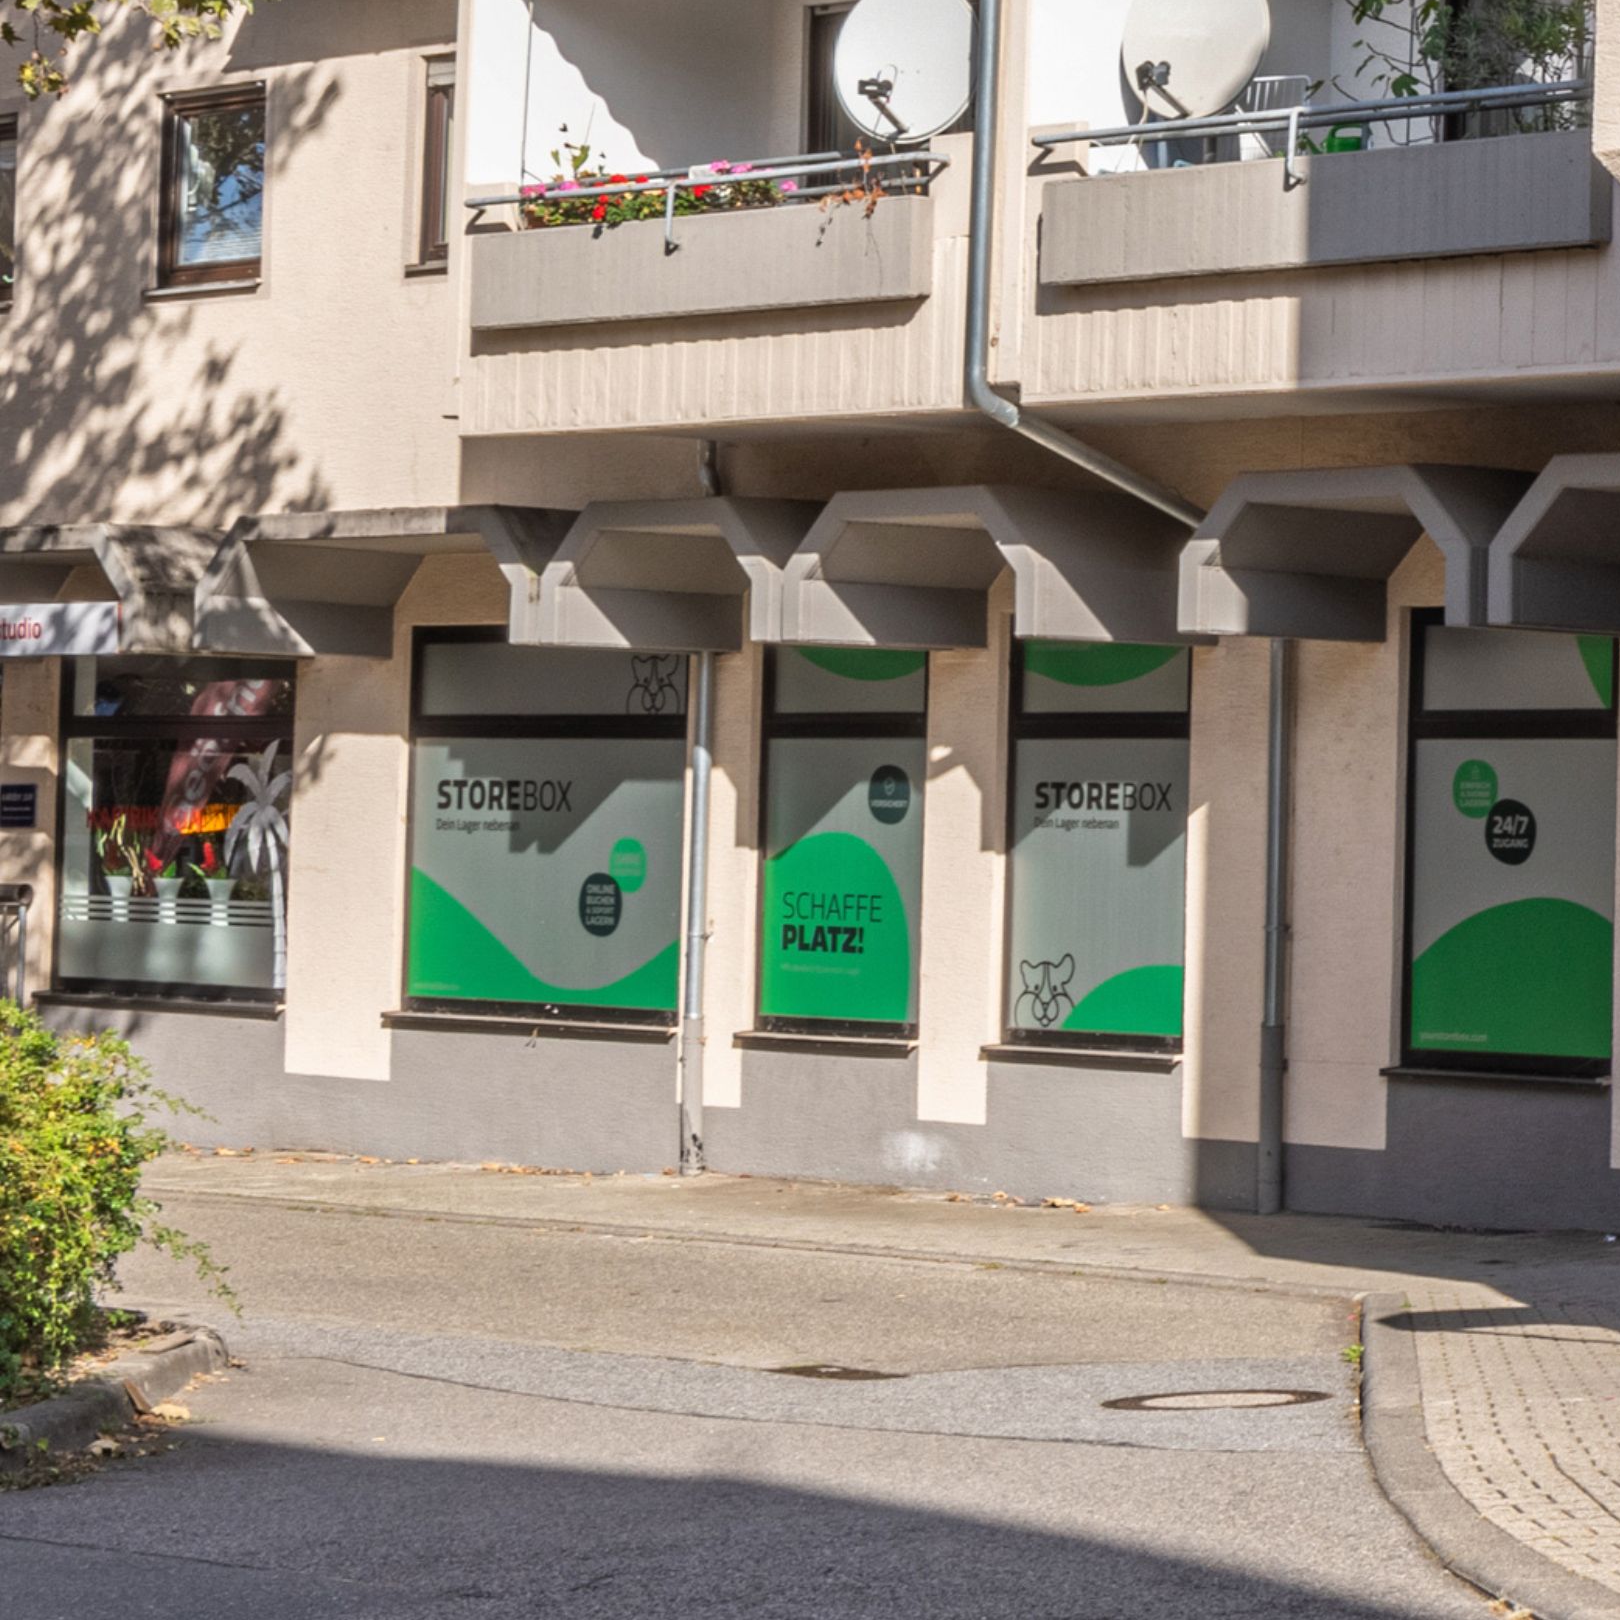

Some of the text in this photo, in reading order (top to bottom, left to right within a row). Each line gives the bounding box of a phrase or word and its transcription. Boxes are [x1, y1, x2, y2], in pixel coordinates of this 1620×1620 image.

[0, 618, 42, 640] tudio
[436, 779, 572, 812] STOREBOX
[1034, 781, 1172, 812] STOREBOX
[1493, 814, 1529, 837] 24/7
[1493, 838, 1529, 848] ZUGANG
[782, 891, 883, 923] SCHAFFE
[782, 923, 864, 954] PLATZ!
